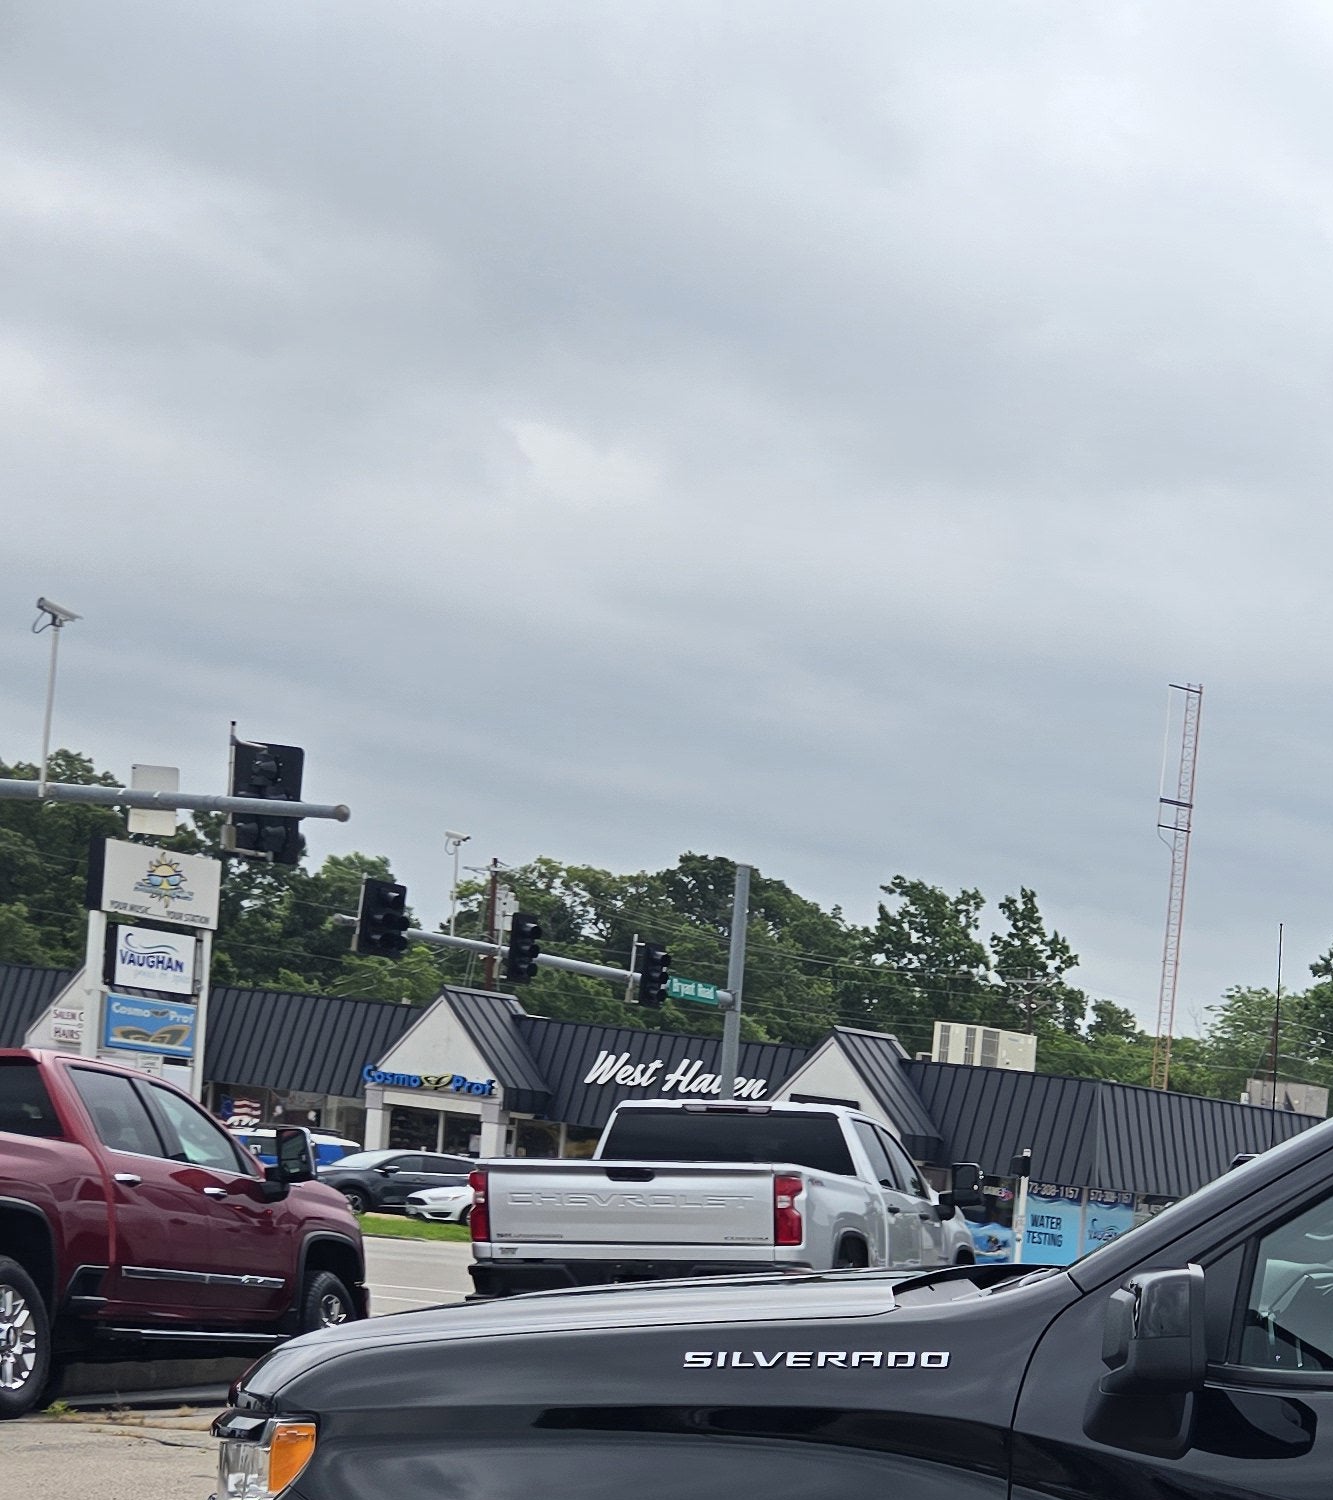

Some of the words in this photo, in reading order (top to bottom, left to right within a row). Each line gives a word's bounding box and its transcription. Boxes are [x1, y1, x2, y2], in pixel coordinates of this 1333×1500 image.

[120, 949, 184, 973] VAUGHAN
[111, 1002, 150, 1018] Cosmo
[168, 1010, 195, 1024] Prof
[363, 1064, 422, 1088] Cosmo
[451, 1074, 496, 1096] Prof
[583, 1050, 664, 1087] West
[661, 1058, 767, 1100] Haen
[1028, 1182, 1080, 1199] 73-308-1157
[508, 1192, 754, 1208] CHEVROLET
[1030, 1214, 1062, 1231] WATER
[1026, 1230, 1063, 1248] TESTING
[683, 1351, 950, 1368] SILVERADO
